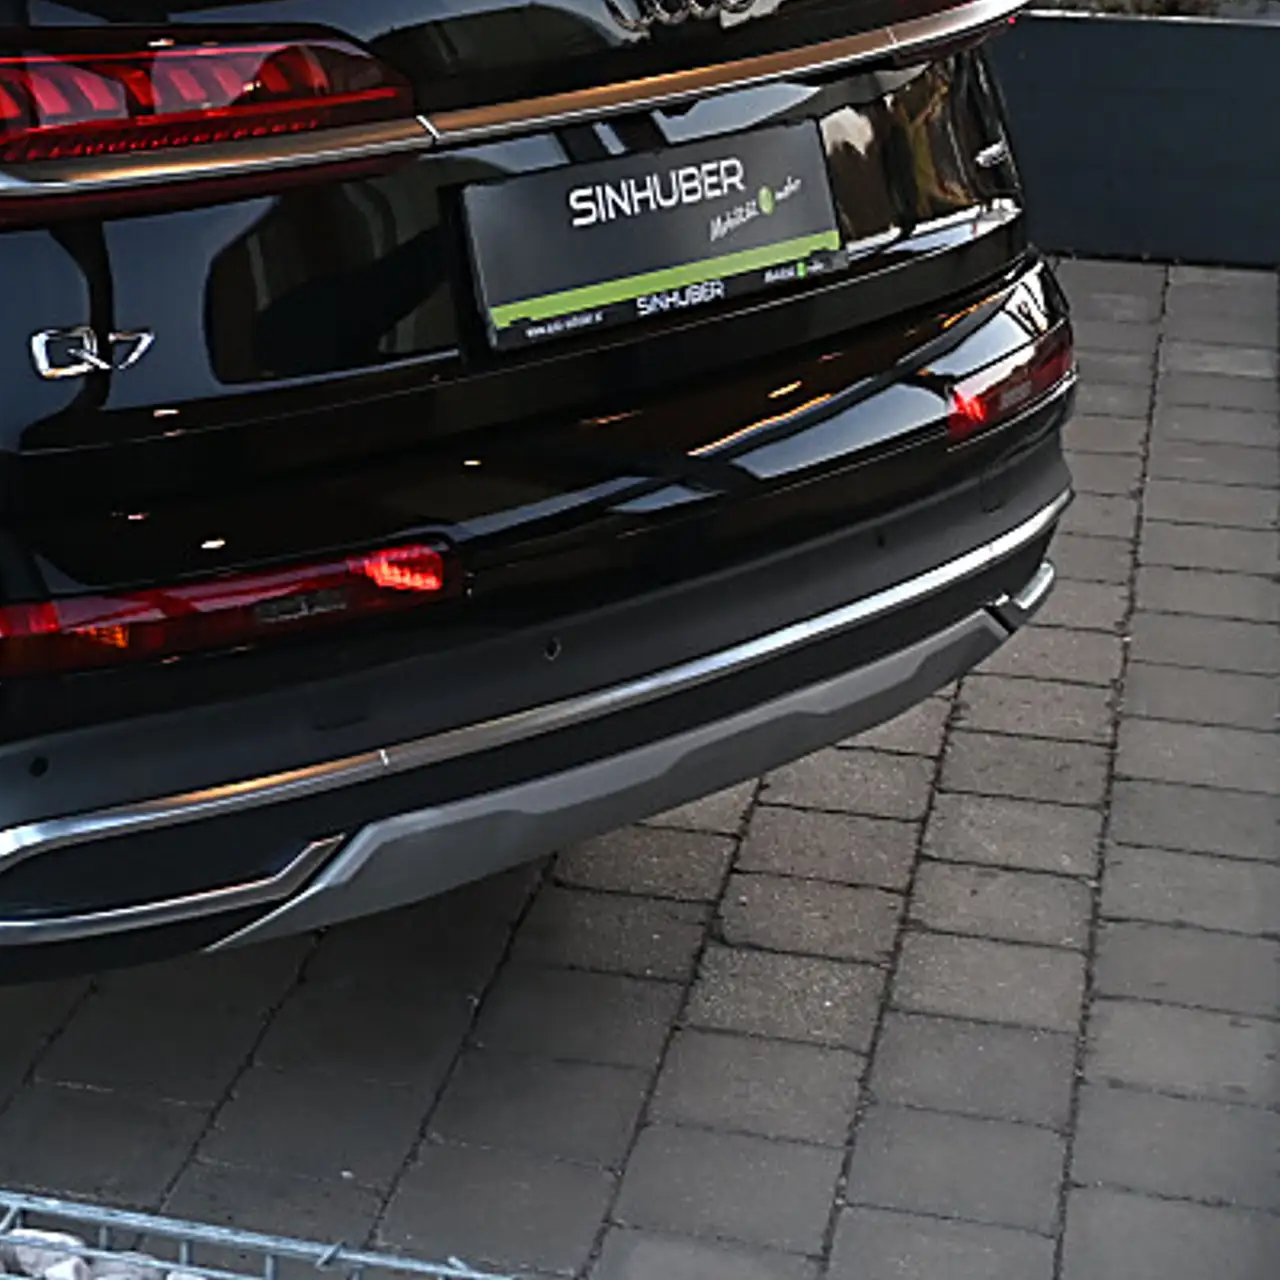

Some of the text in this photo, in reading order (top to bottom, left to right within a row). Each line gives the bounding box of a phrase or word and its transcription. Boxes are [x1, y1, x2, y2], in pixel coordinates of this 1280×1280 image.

[569, 157, 746, 227] SINHUBER
[636, 279, 726, 317] SINHUBER
[32, 325, 155, 378] Q7
